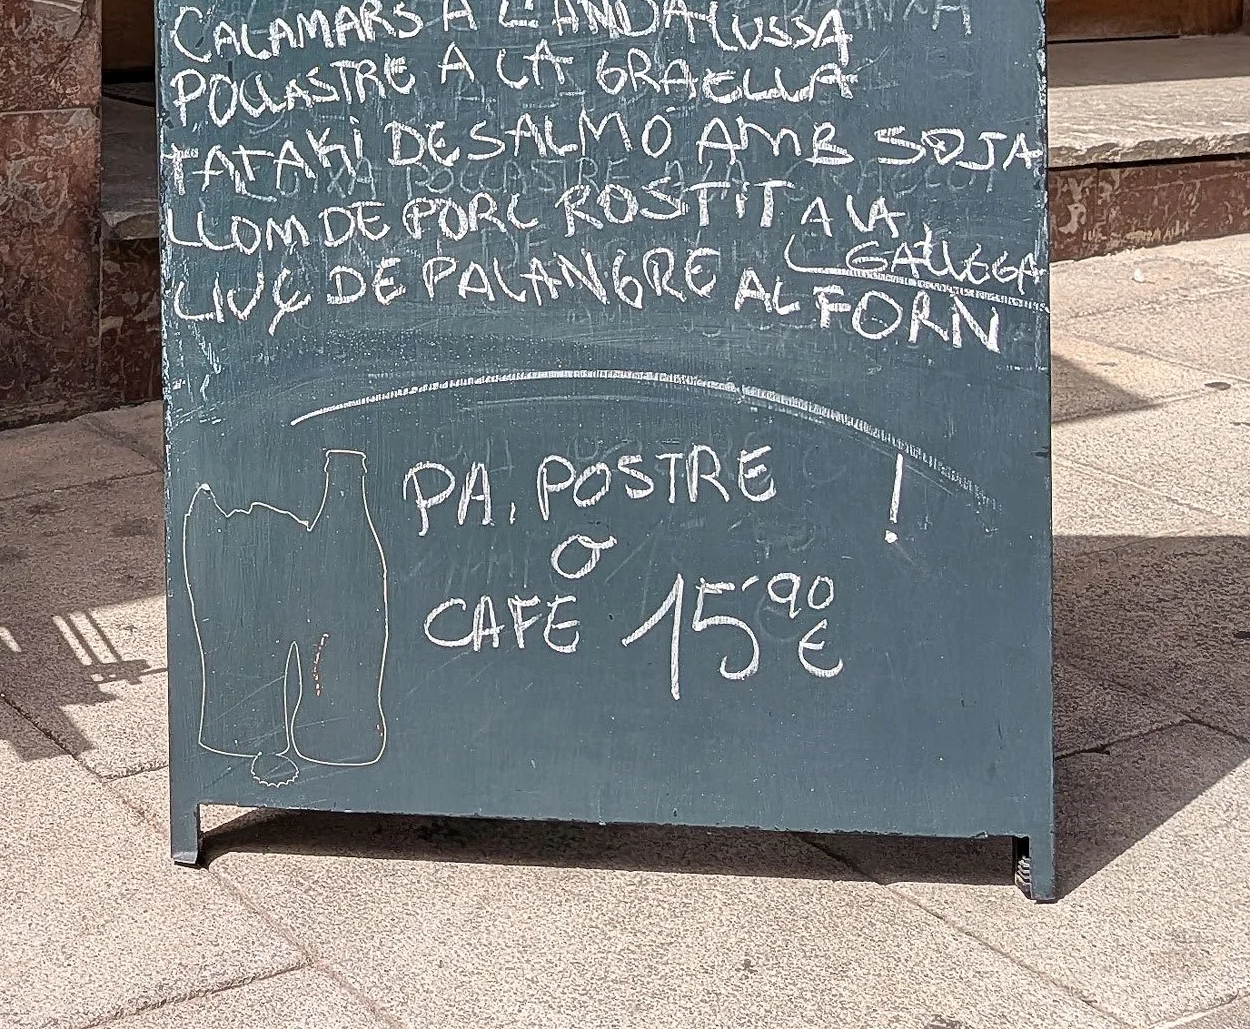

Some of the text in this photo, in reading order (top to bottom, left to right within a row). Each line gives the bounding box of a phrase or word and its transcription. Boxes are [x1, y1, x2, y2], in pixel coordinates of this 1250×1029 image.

[170, 39, 858, 127] POLLASTRE A LA GRAELLA
[383, 120, 461, 167] DE
[696, 115, 854, 167] AMB
[874, 125, 1043, 171] SOJA
[166, 208, 311, 255] LLOM
[317, 201, 390, 248] DE
[402, 192, 538, 241] PORC
[554, 177, 795, 236] ROSTIT
[801, 196, 833, 237] A
[326, 257, 407, 305] DE
[422, 247, 720, 310] PALANGRE
[734, 267, 800, 314] AL
[813, 285, 1000, 354] FORN
[537, 444, 777, 521] POSTRE
[423, 594, 581, 653] CAFE
